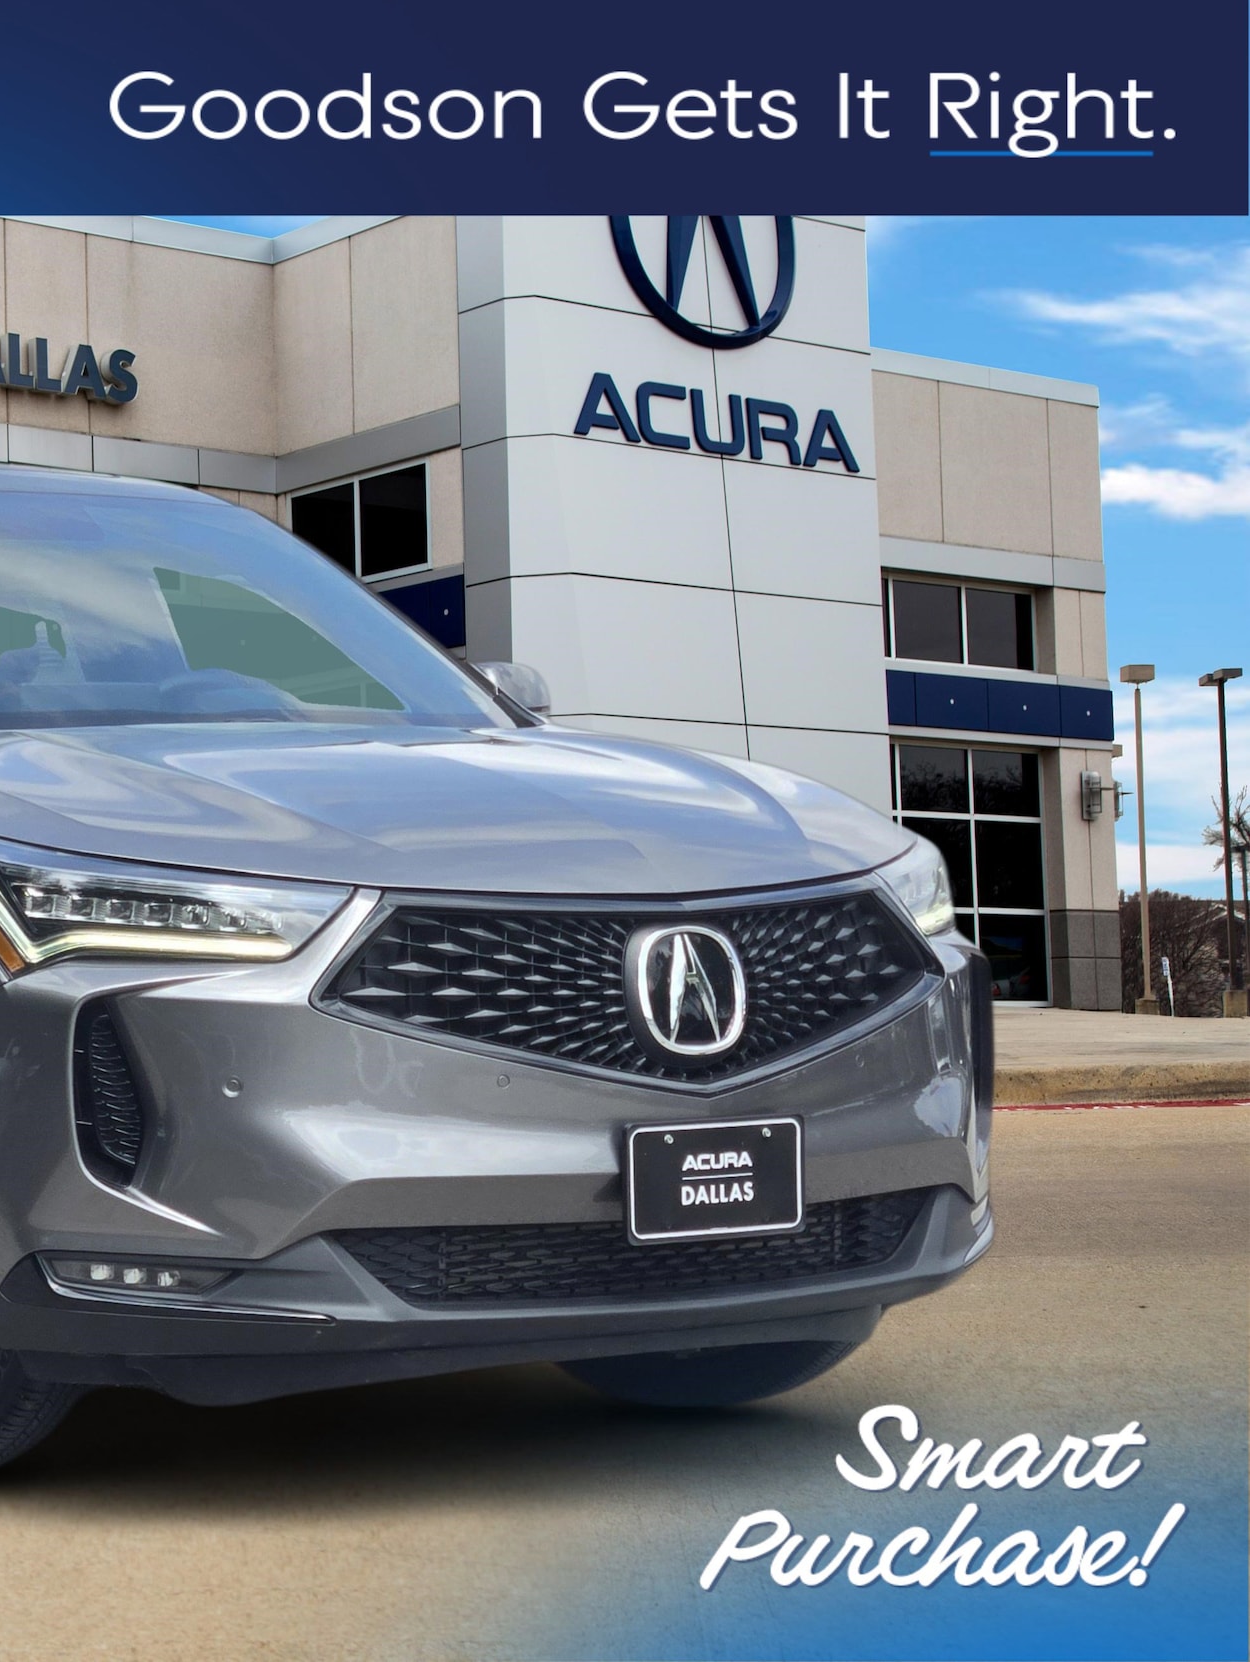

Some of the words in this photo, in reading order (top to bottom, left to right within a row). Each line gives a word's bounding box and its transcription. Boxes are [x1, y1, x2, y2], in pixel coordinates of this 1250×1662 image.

[573, 372, 859, 473] ACURA
[682, 1151, 753, 1171] ACURA
[681, 1182, 754, 1206] DALLAS
